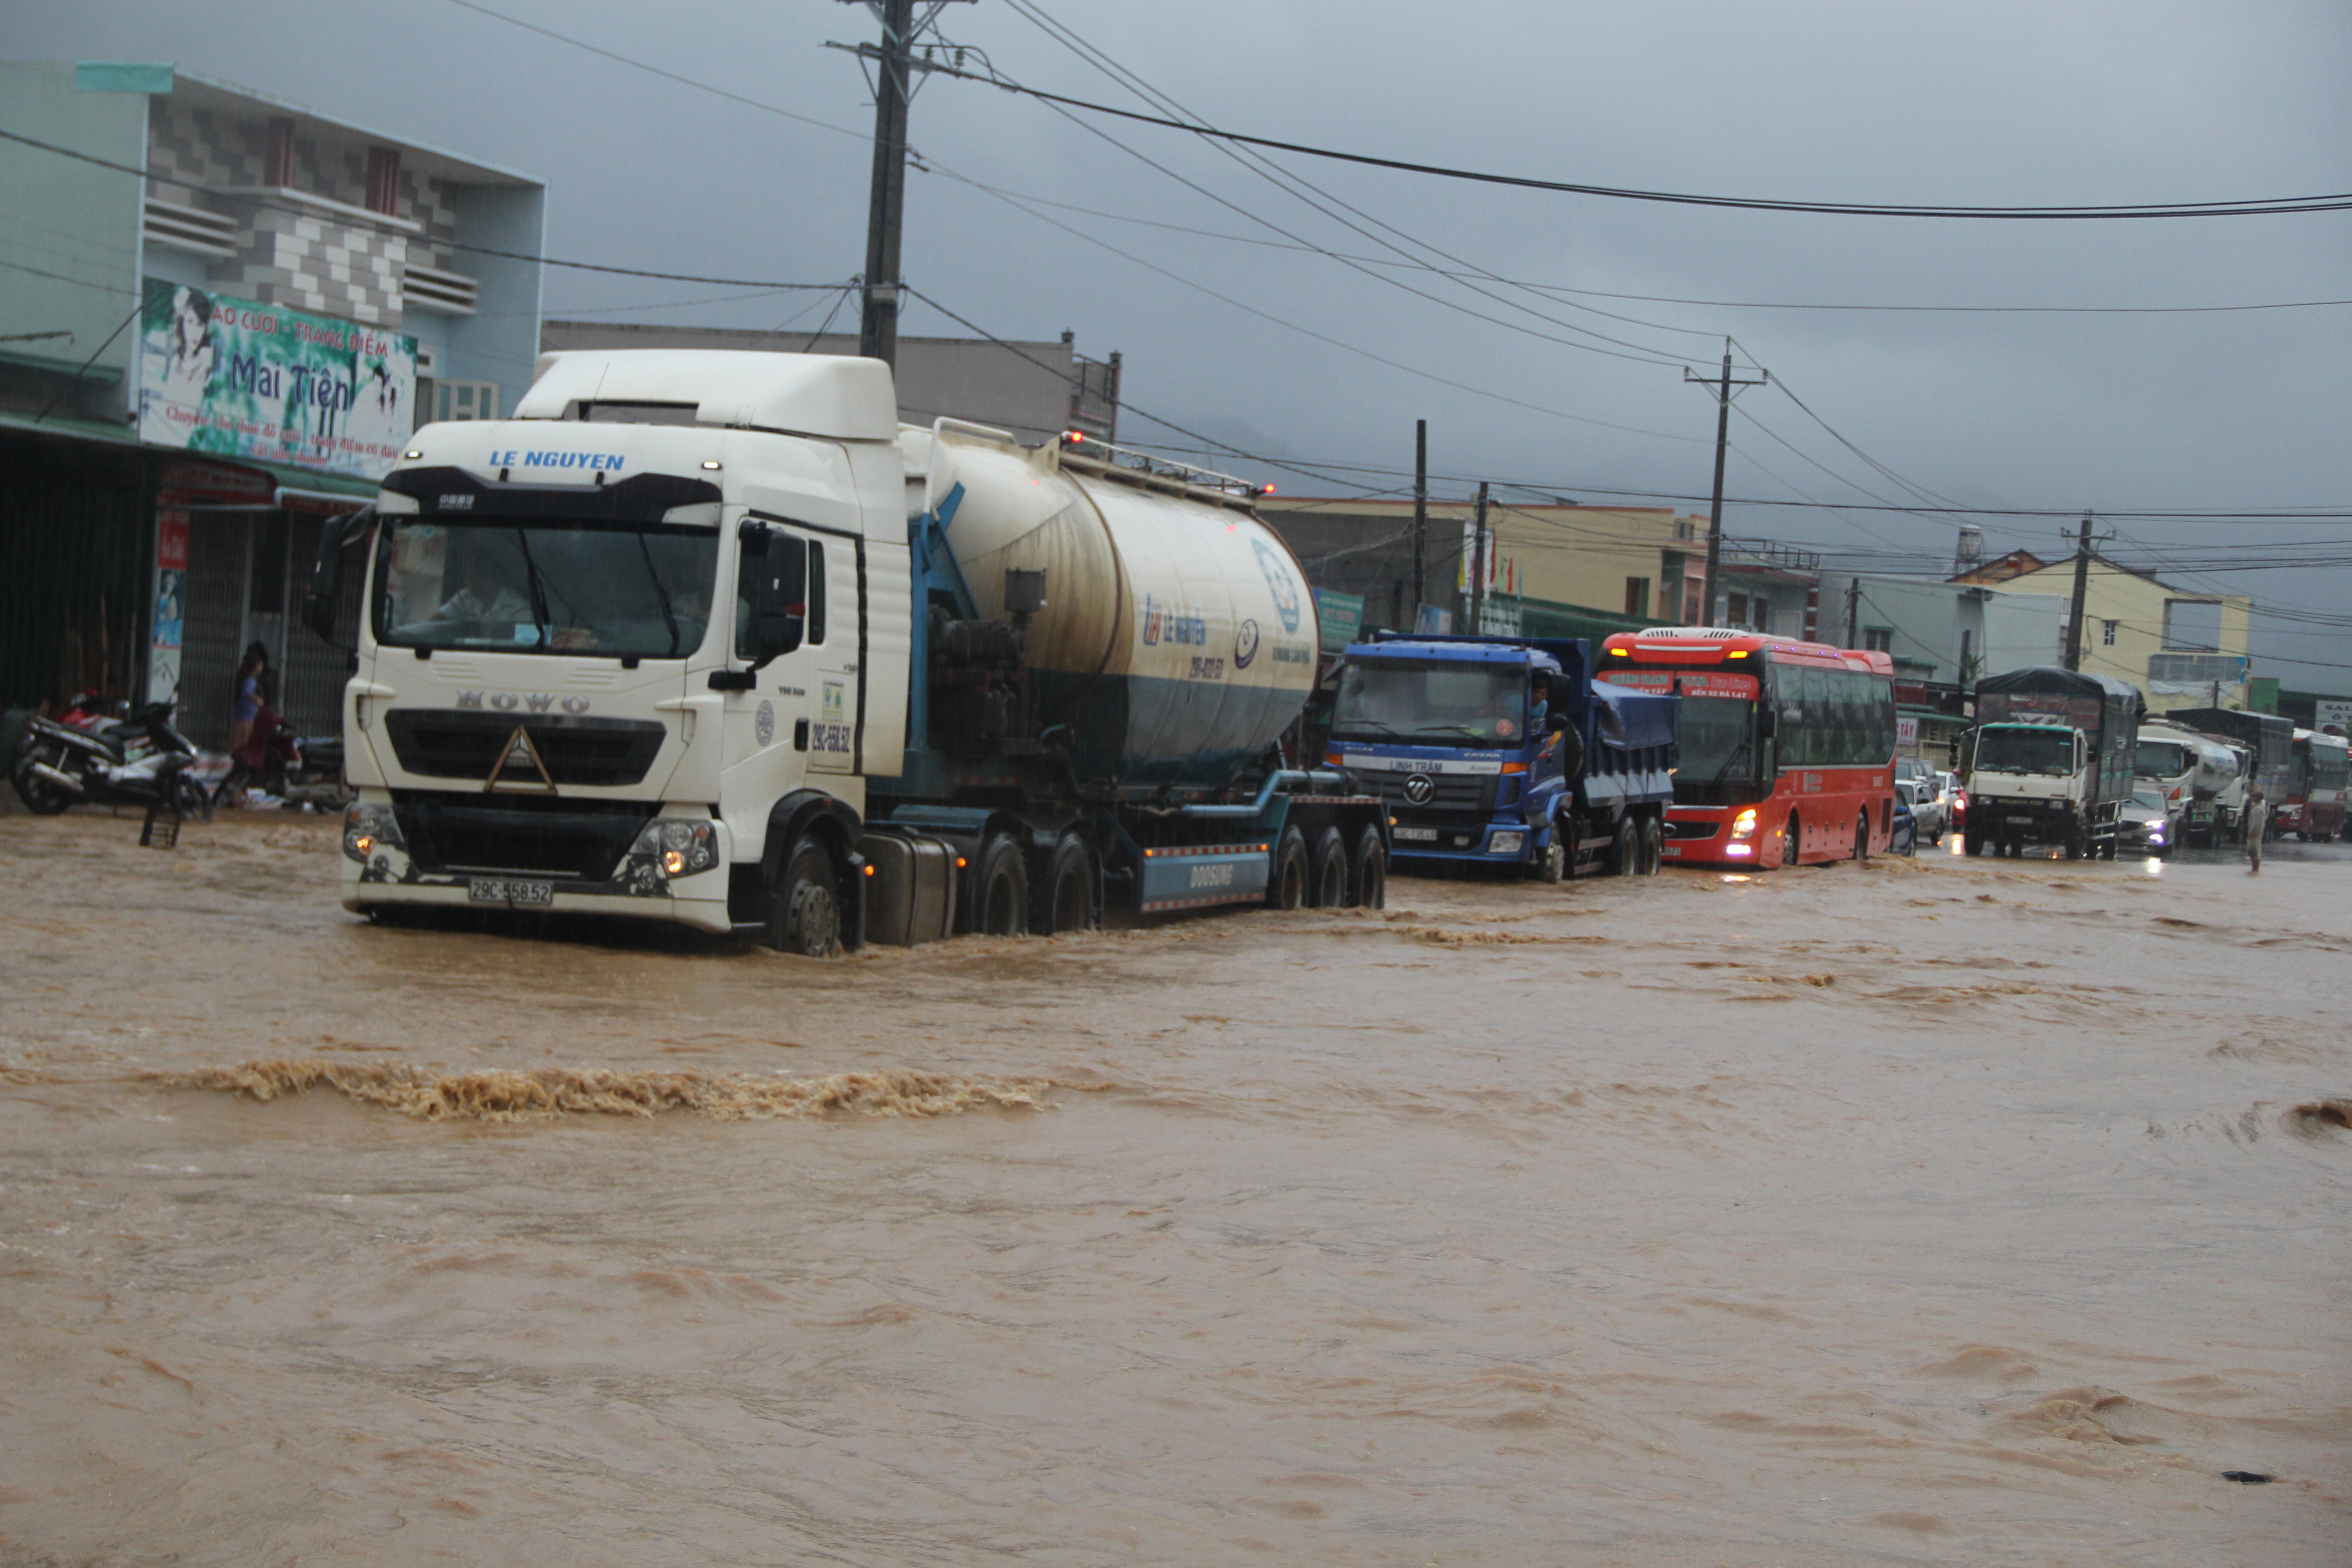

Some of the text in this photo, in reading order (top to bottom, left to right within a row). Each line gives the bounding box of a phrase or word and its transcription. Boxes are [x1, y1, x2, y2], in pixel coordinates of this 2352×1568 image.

[212, 300, 236, 325] ÁO
[295, 322, 344, 350] TRANG
[232, 352, 281, 399] Mai
[490, 451, 625, 470] LE NGUYEN
[456, 690, 590, 714] HOWO
[1390, 760, 1412, 772] LINH
